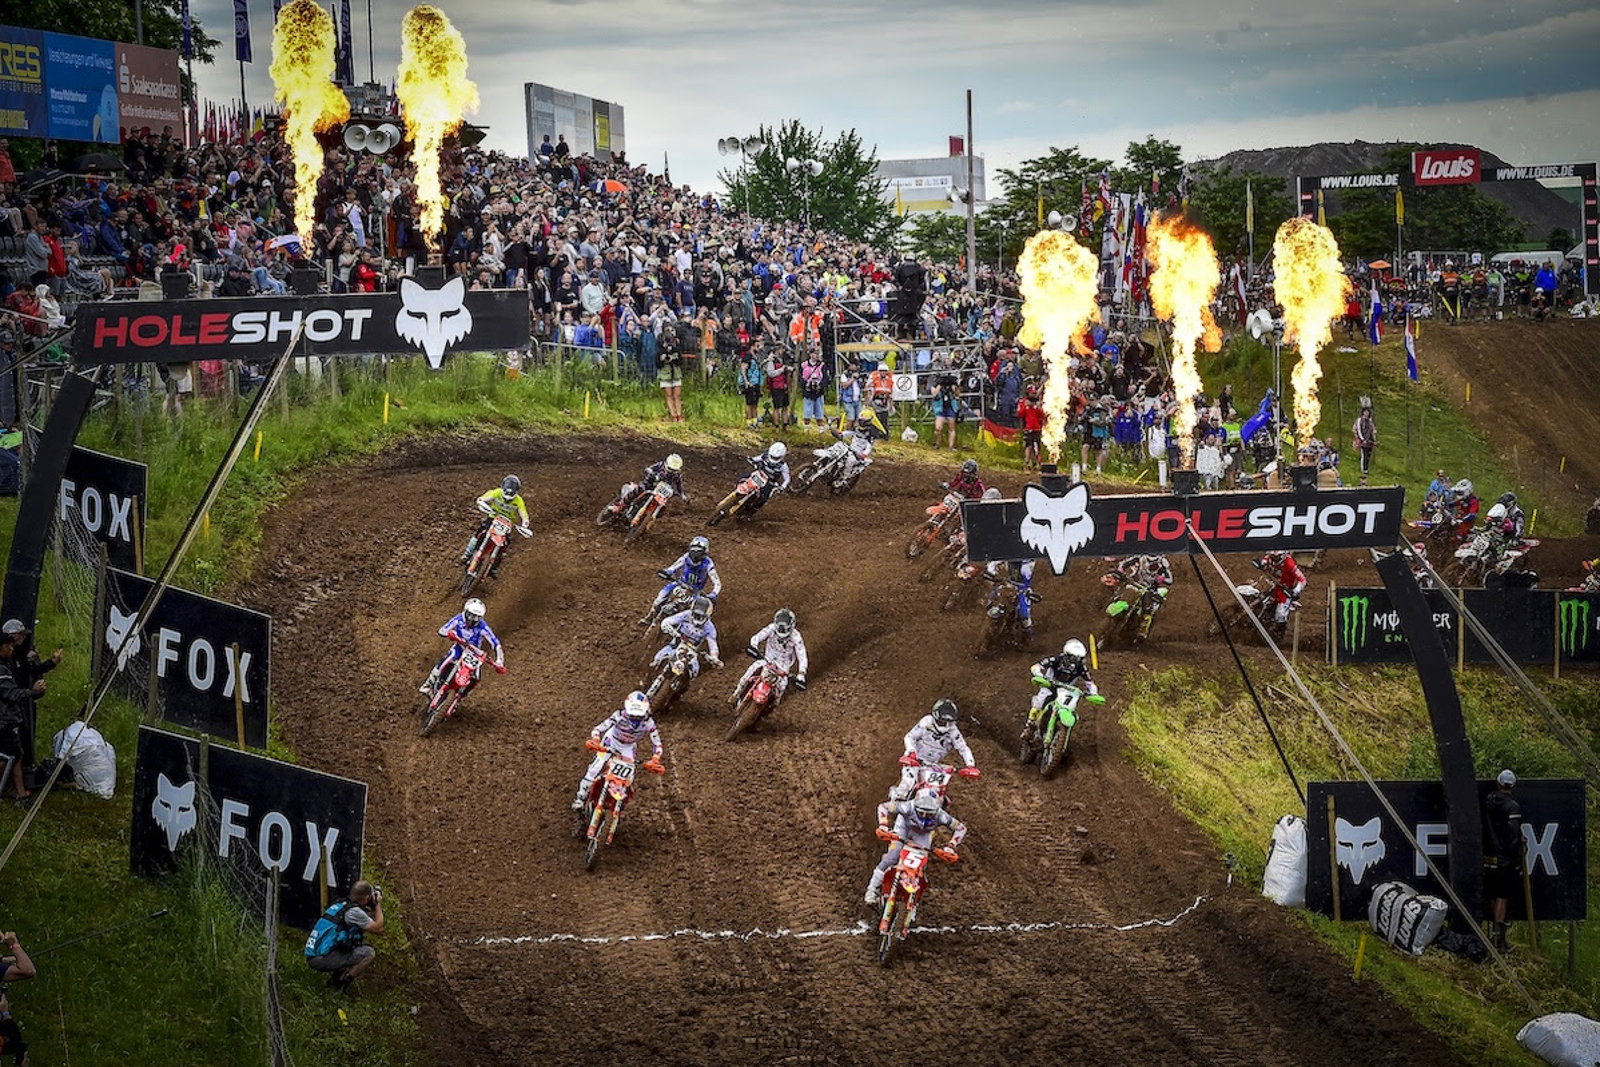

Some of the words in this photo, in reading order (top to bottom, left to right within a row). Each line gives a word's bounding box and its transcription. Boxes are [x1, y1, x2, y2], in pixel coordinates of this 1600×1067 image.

[131, 74, 178, 99] Saalesparkasse
[1320, 173, 1399, 188] WWW.LOUIS.DE
[1497, 165, 1575, 180] WWW.LOUIS.DE
[94, 309, 372, 348] HOLESHOT
[60, 478, 131, 541] FOX
[1115, 503, 1385, 543] HOLESHOT
[1373, 610, 1451, 631] MOER
[157, 626, 252, 703] FOX
[463, 653, 479, 667] 24
[612, 763, 632, 778] 80
[928, 772, 945, 784] 84
[218, 798, 340, 888] FOX
[1415, 823, 1558, 876] FX
[904, 852, 924, 869] 5
